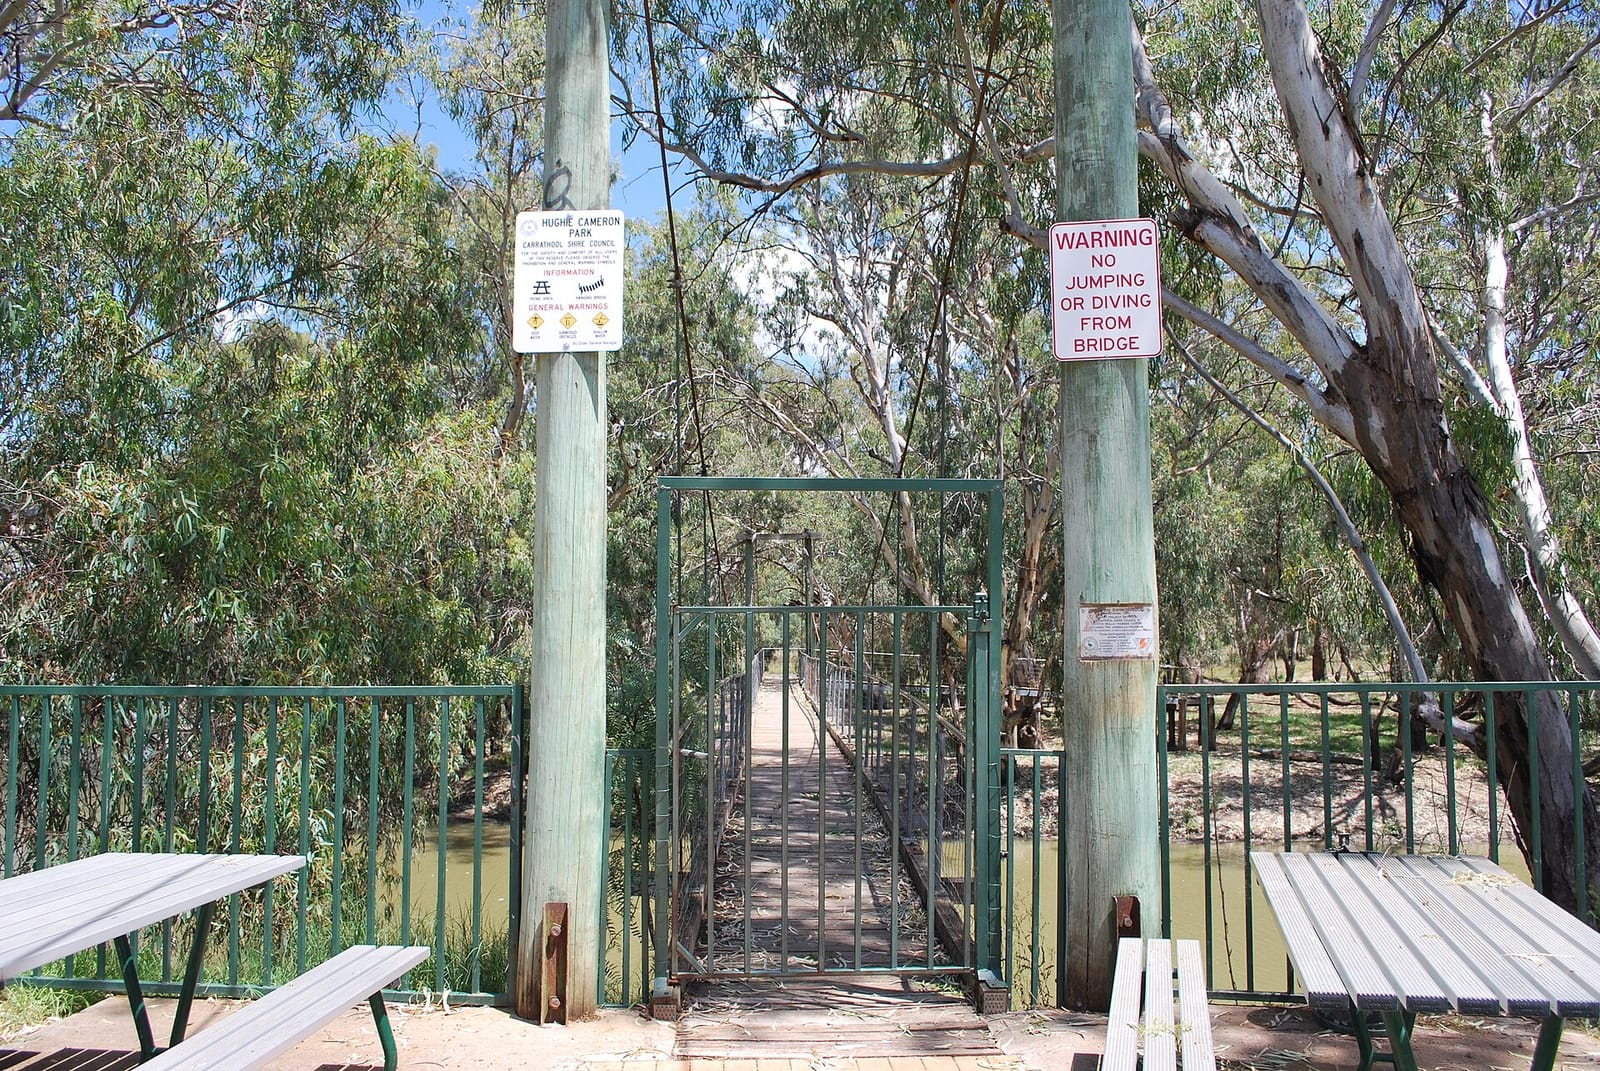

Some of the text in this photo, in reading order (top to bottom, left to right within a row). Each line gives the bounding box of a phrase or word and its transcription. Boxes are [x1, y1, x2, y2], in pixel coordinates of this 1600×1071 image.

[542, 217, 620, 227] HUGHIE CAMERON
[569, 228, 592, 237] PARK
[1056, 228, 1152, 250] WARNING
[1091, 254, 1116, 268] NO
[1065, 273, 1145, 290] JUMPING
[1060, 294, 1151, 311] OR DIVING
[1081, 316, 1132, 331] FROM
[1074, 336, 1140, 352] BRIDGE
